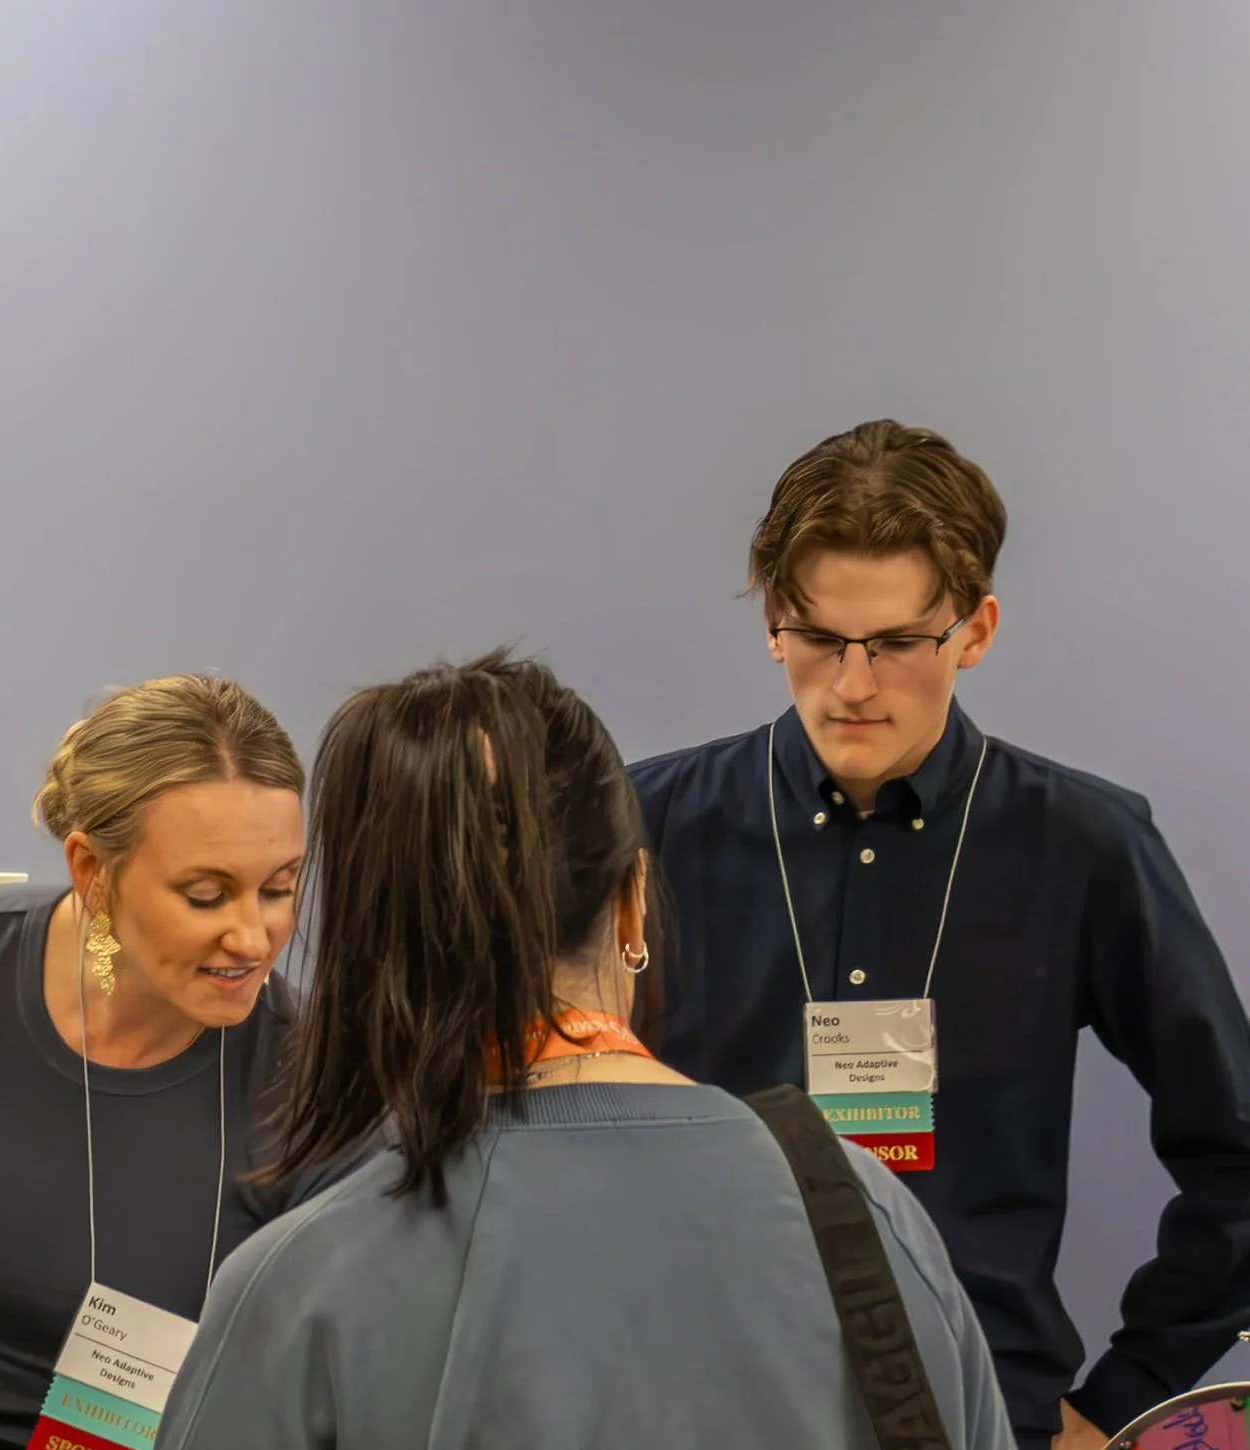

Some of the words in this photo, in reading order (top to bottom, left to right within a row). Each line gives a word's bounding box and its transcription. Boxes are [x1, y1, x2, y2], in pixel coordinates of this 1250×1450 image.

[811, 1015, 840, 1028] Neo
[812, 1032, 850, 1045] Crooks
[834, 1061, 853, 1070] Neo
[856, 1060, 898, 1071] Adaptive
[849, 1073, 885, 1083] Designs
[88, 1295, 117, 1317] Kim
[81, 1314, 128, 1342] O'Geary
[91, 1349, 112, 1364] Neo
[113, 1359, 155, 1382] Adaptive
[99, 1368, 136, 1390] Designs
[61, 1391, 157, 1440] EXHIBITOR
